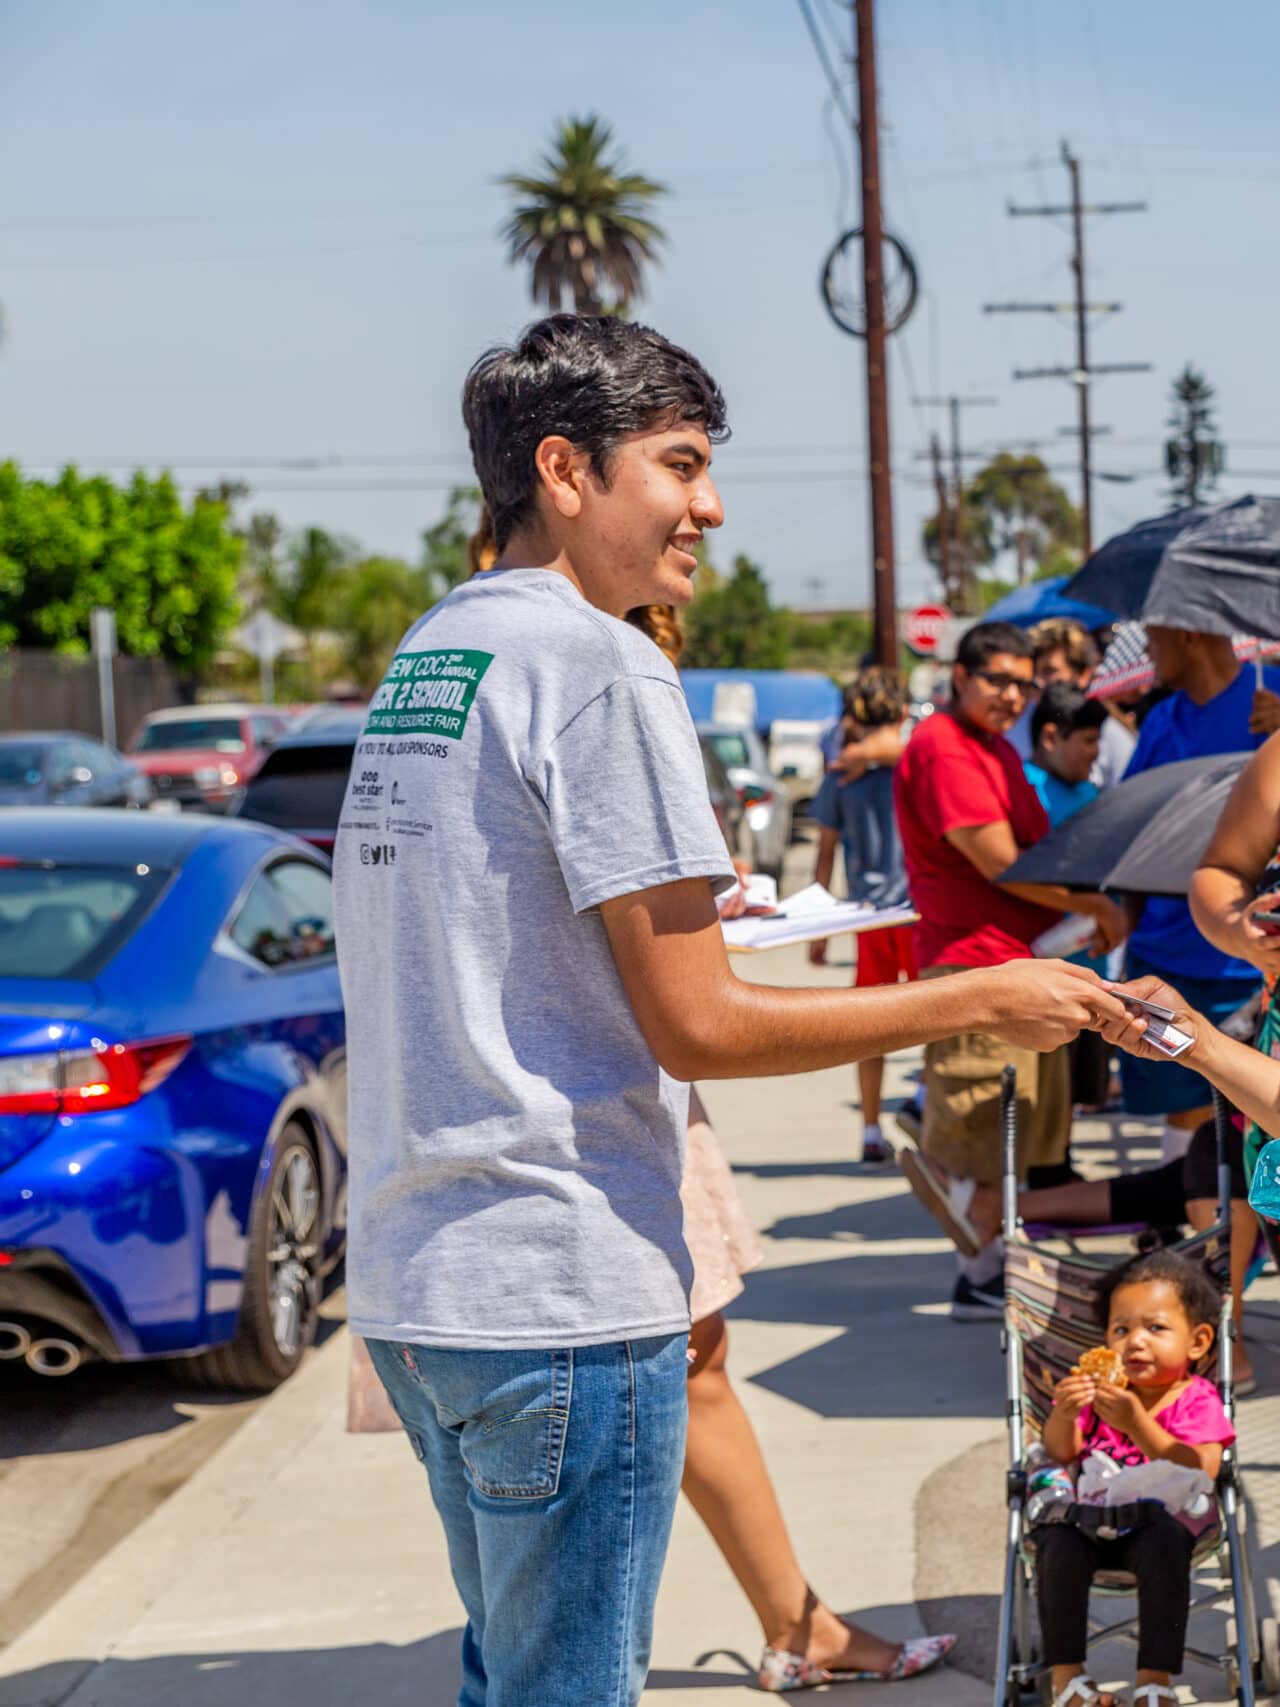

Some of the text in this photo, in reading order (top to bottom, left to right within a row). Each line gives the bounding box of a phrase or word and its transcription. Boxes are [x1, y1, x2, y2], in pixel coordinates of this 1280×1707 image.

[414, 656, 445, 676] CDC
[442, 665, 478, 680] ANNUAL
[395, 682, 412, 709] 2
[407, 680, 468, 712] SCHOOL
[381, 715, 396, 728] AND
[397, 713, 435, 728] RESOURCE
[433, 714, 461, 731] FAIR
[406, 741, 448, 758] SPONSORS
